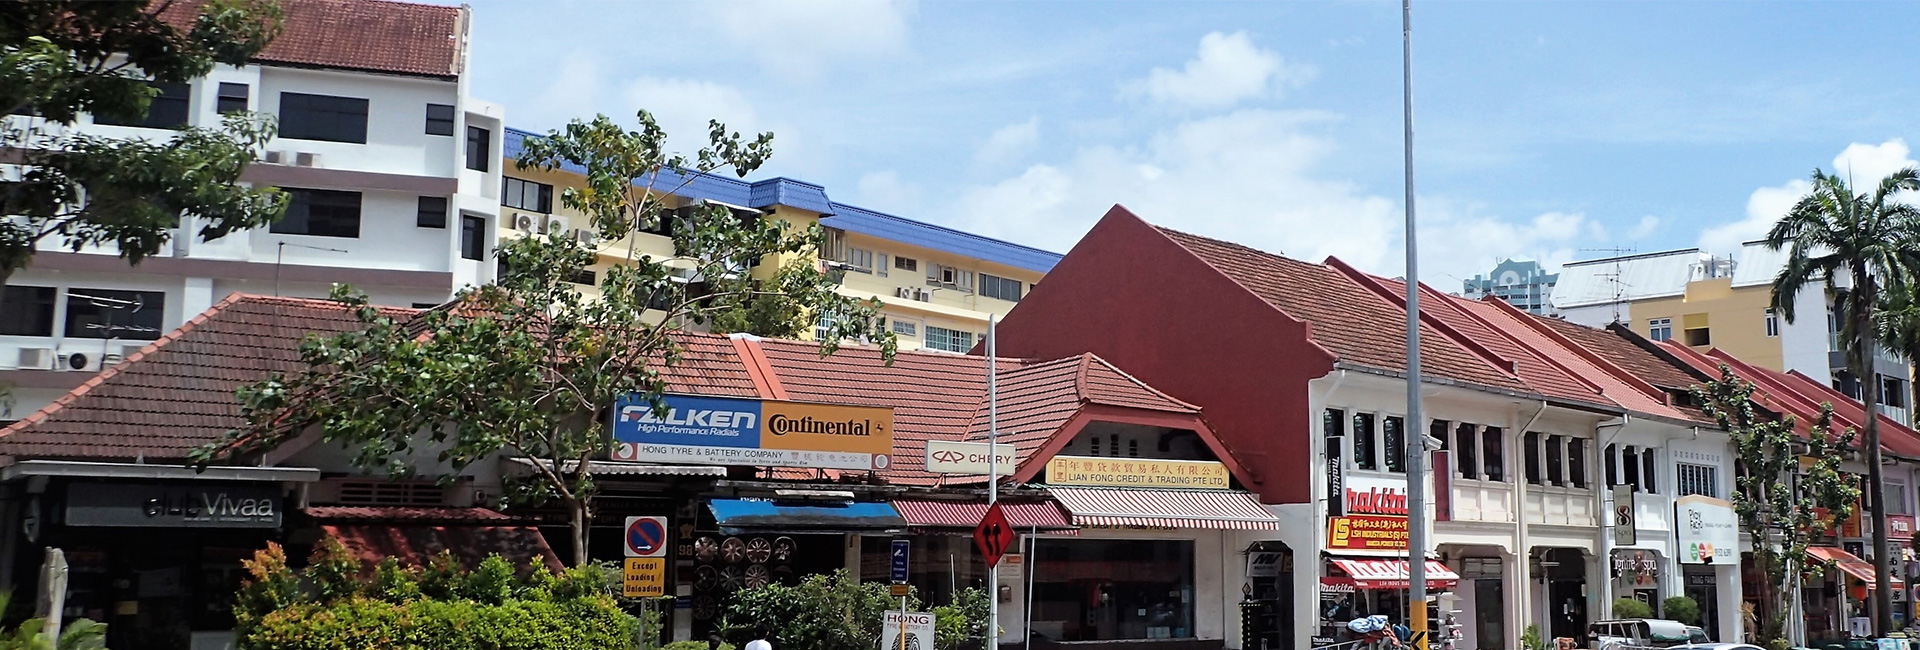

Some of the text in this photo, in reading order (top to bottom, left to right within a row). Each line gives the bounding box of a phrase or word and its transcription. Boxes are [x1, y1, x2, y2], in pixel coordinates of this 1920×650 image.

[620, 405, 756, 429] FALKEN
[637, 423, 740, 437] High Performance Radials
[768, 413, 870, 437] Continental
[642, 445, 667, 454] HONG
[670, 447, 692, 455] TYRE
[705, 448, 741, 457] BATTERY
[744, 450, 783, 459] COMPANY
[969, 453, 1011, 464] CHERY
[1069, 461, 1223, 476] 年豐貸款貿易私人有限公司
[1069, 473, 1087, 481] LIAN
[1091, 474, 1113, 482] FONG
[1117, 475, 1145, 483] CREDIT
[1148, 475, 1153, 483] &
[1156, 475, 1190, 484] TRADING
[1193, 476, 1207, 484] PTE
[679, 545, 693, 556] 98
[632, 562, 657, 570] Except
[626, 573, 655, 582] Loading
[626, 585, 662, 593] Unloading
[887, 615, 929, 624] HONG
